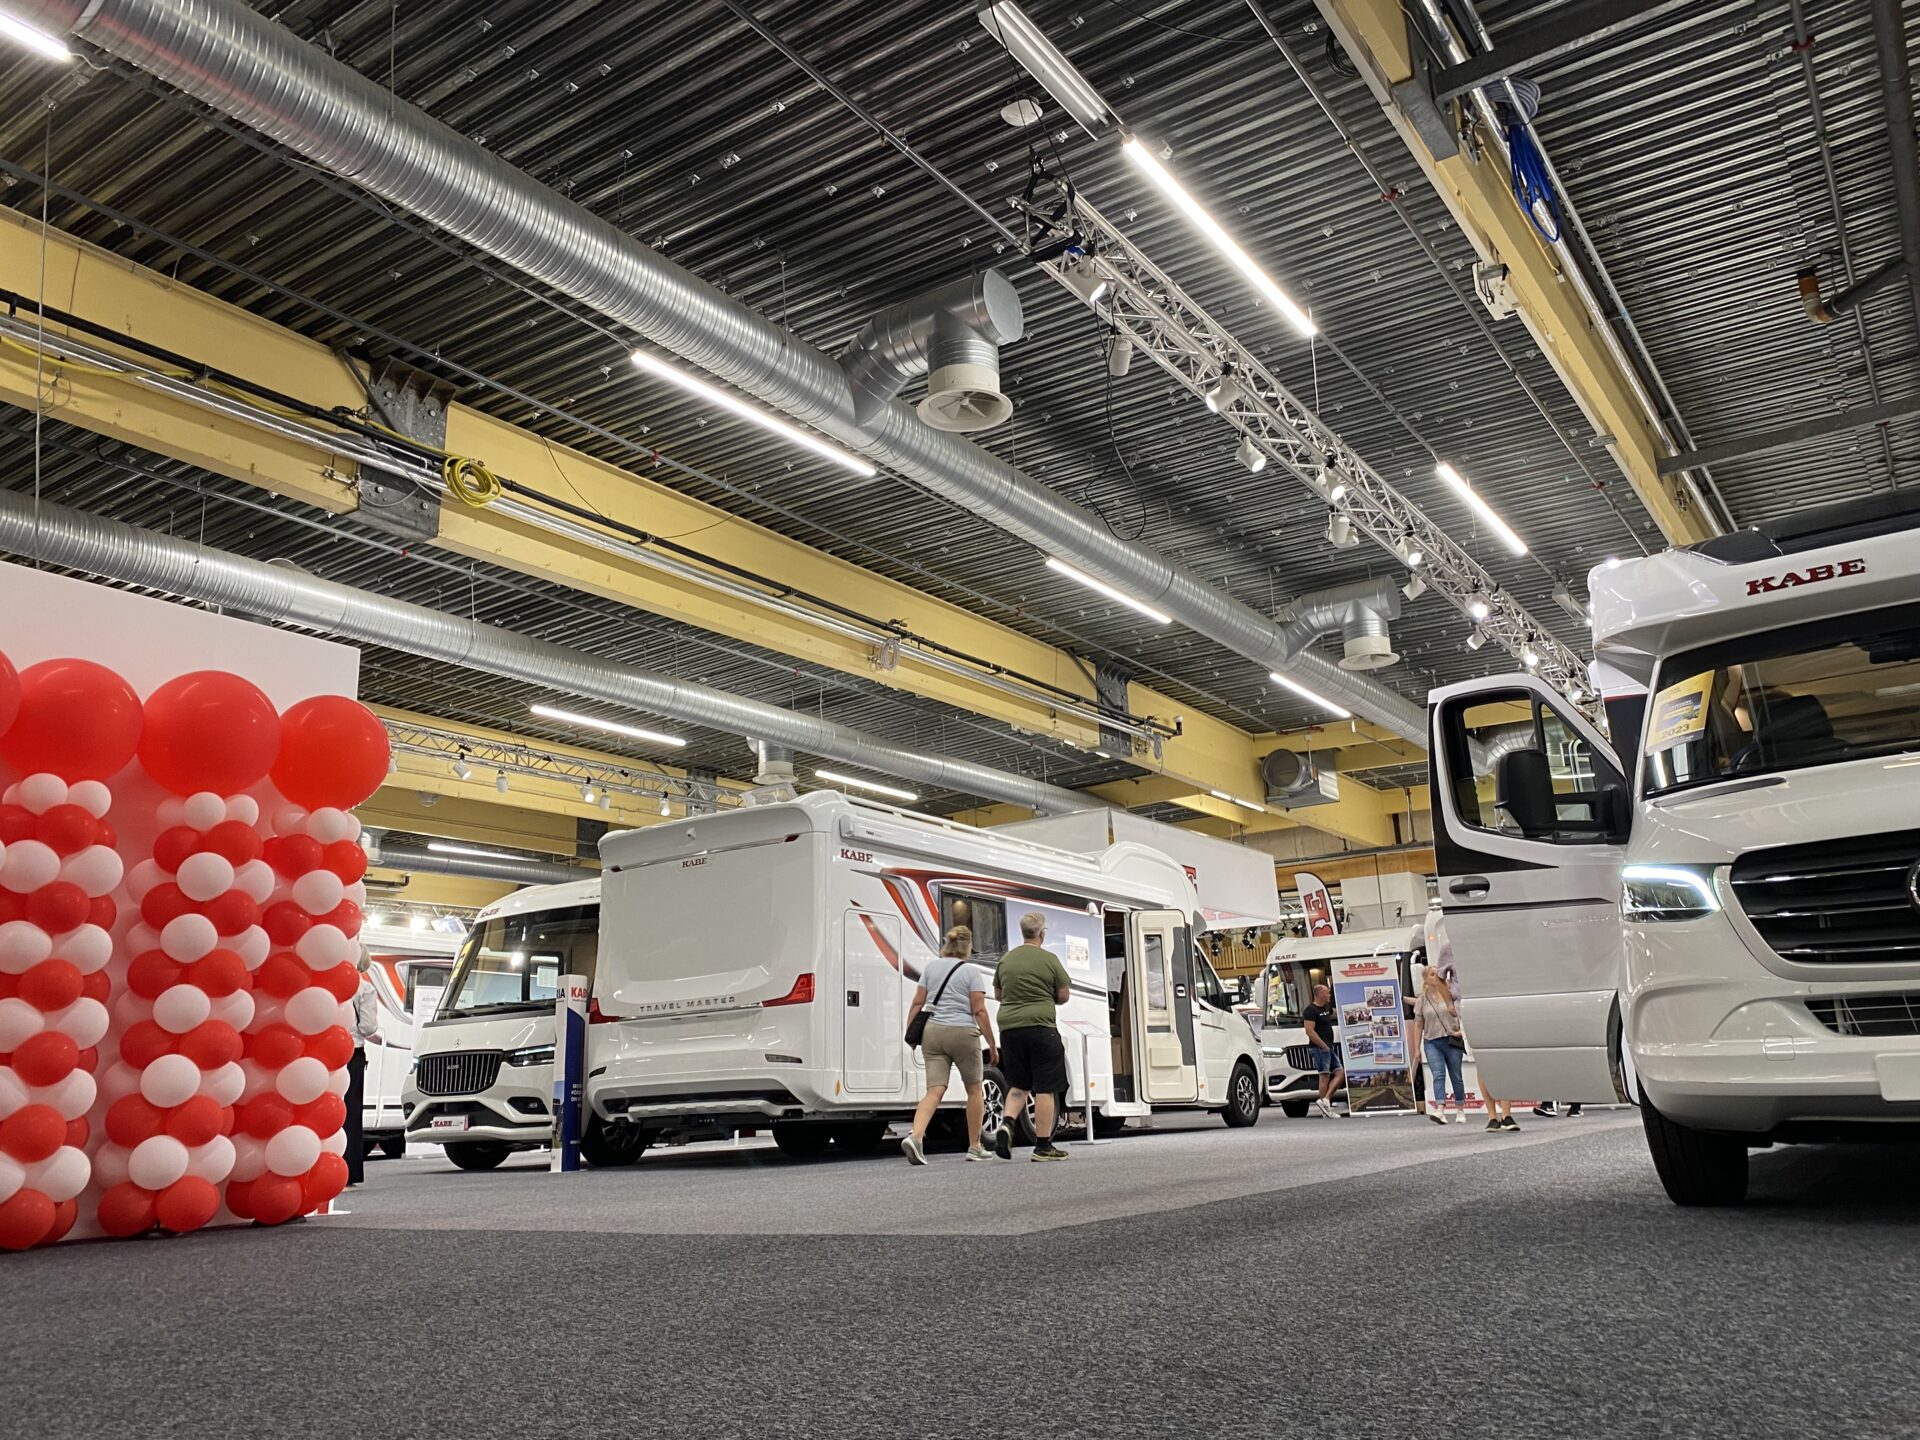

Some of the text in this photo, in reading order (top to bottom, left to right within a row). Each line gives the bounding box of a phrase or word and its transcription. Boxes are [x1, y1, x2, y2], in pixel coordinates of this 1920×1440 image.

[1746, 558, 1866, 596] KABE
[1662, 723, 1690, 738] 2023
[682, 857, 708, 868] KABE
[840, 848, 873, 863] KABE
[1348, 962, 1380, 970] KABE
[639, 996, 735, 1013] TRAVEL MASTER
[434, 1120, 453, 1128] KABE
